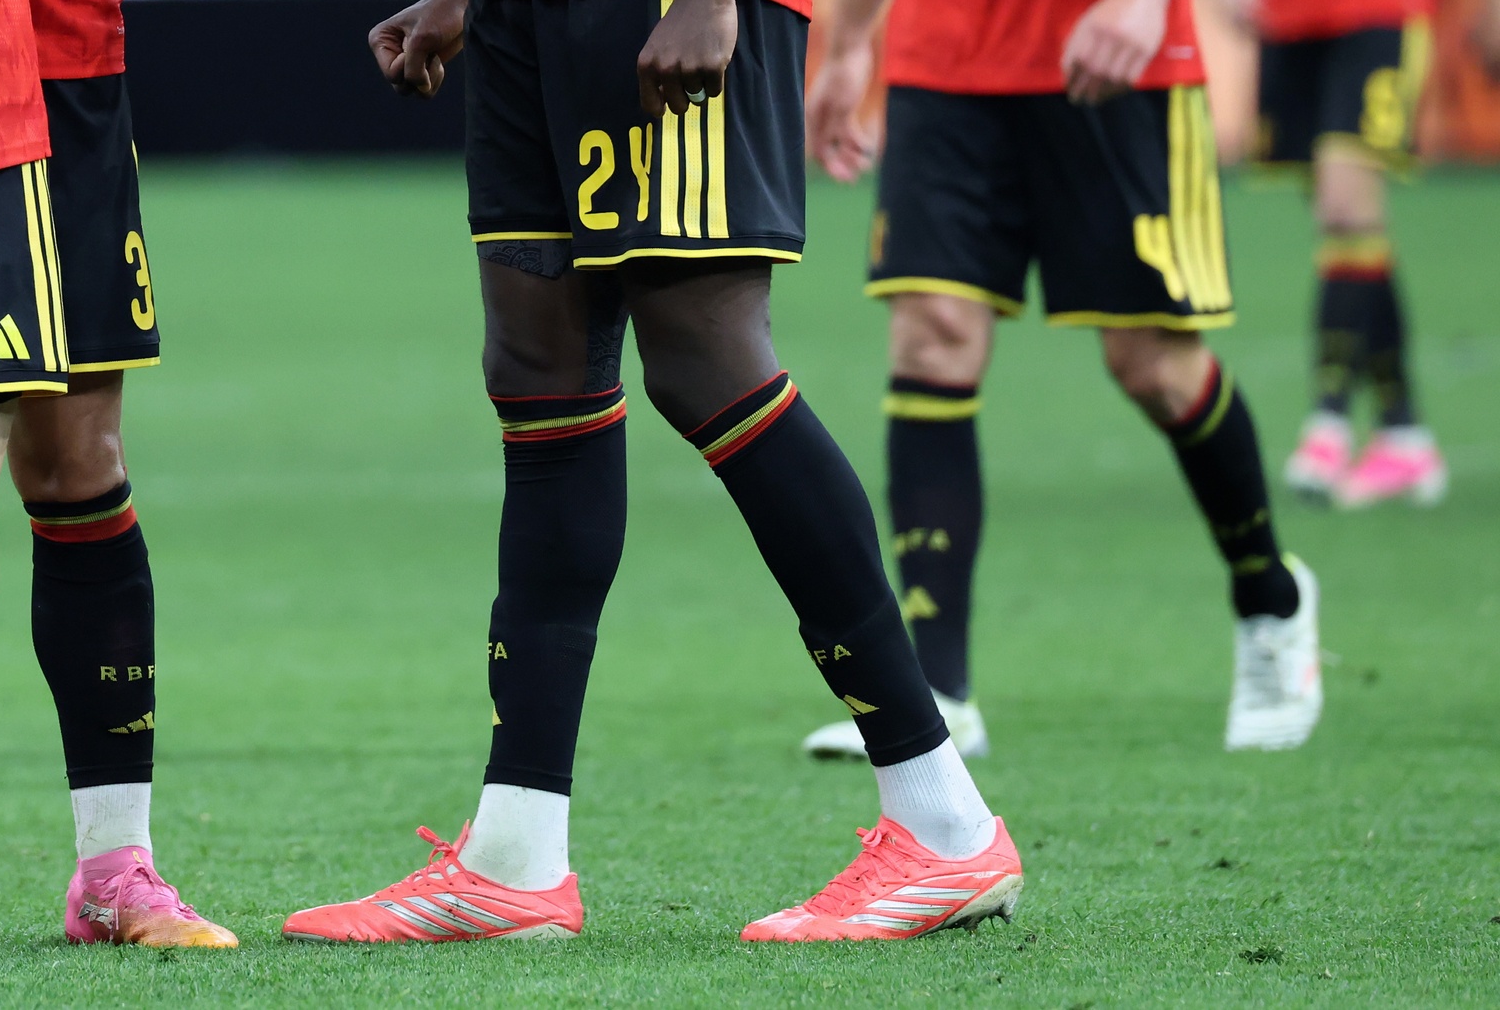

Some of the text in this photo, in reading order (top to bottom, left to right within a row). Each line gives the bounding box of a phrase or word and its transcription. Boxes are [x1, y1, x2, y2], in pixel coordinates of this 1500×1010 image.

[578, 121, 653, 230] 24
[124, 230, 155, 331] 3
[1133, 214, 1185, 302] 4
